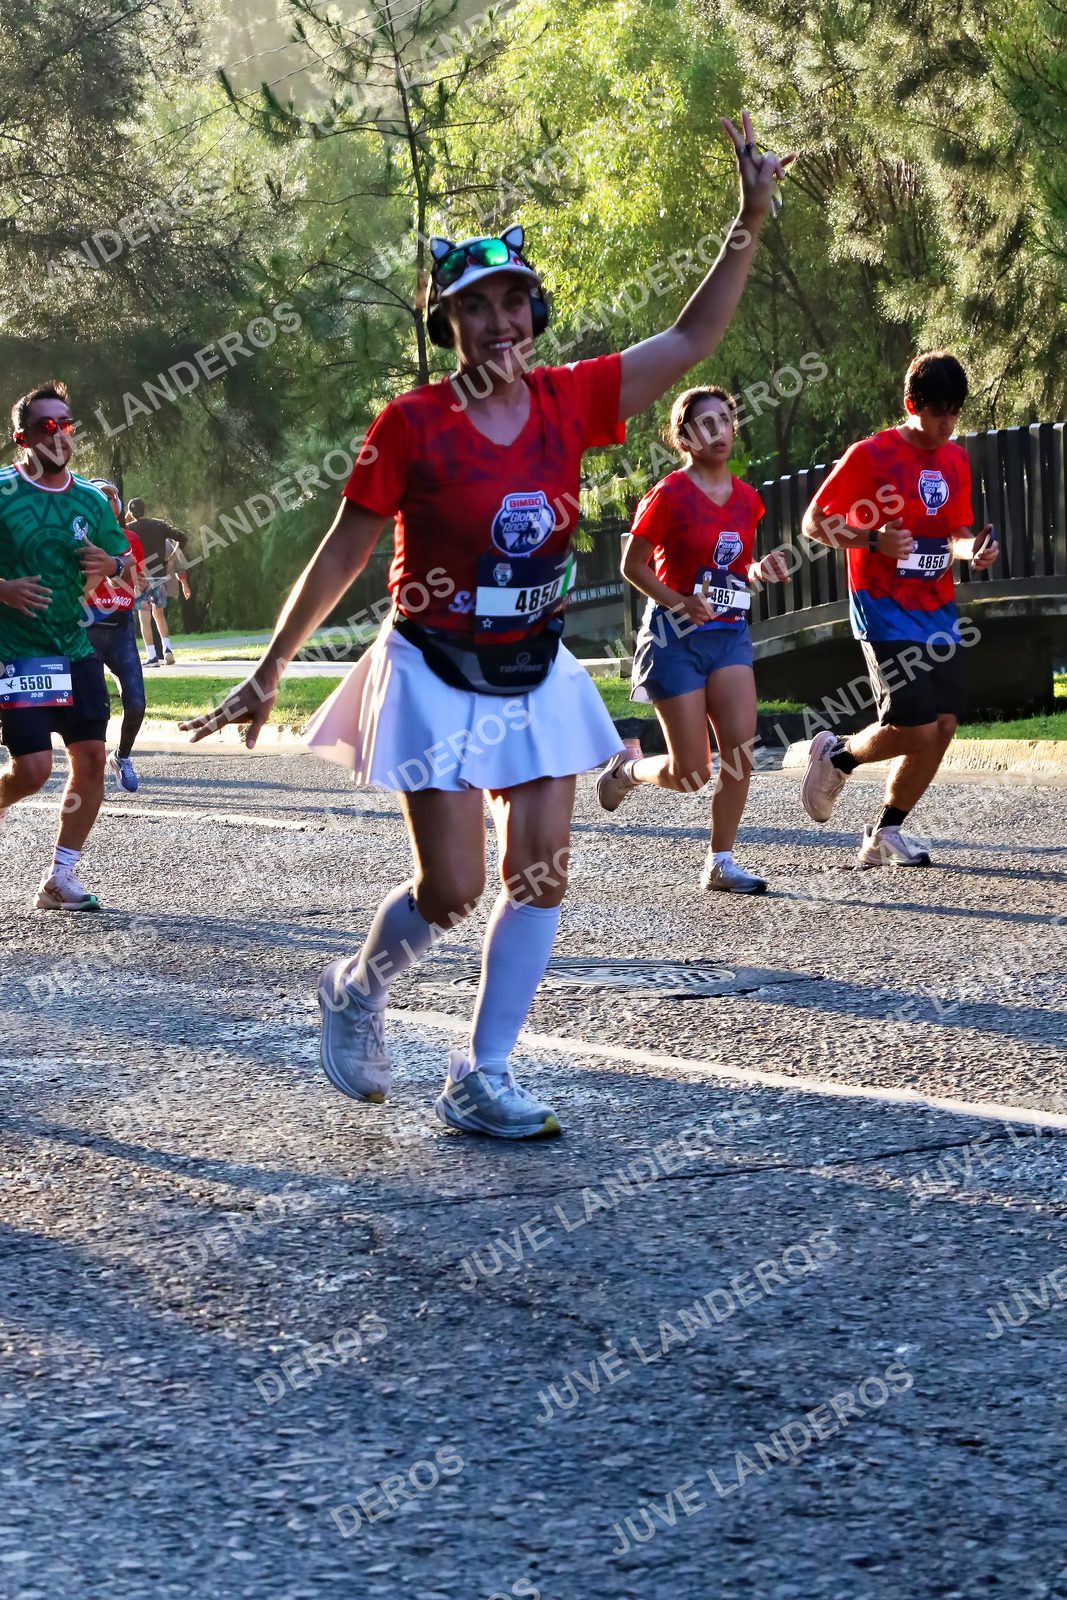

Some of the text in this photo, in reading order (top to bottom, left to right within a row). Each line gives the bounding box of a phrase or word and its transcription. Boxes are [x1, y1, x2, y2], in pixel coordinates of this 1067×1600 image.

[510, 498, 541, 507] BIMBO
[510, 510, 541, 523] Global
[918, 555, 945, 569] 4856
[515, 581, 559, 613] 4850
[710, 588, 736, 606] 4857
[19, 675, 53, 691] 5580
